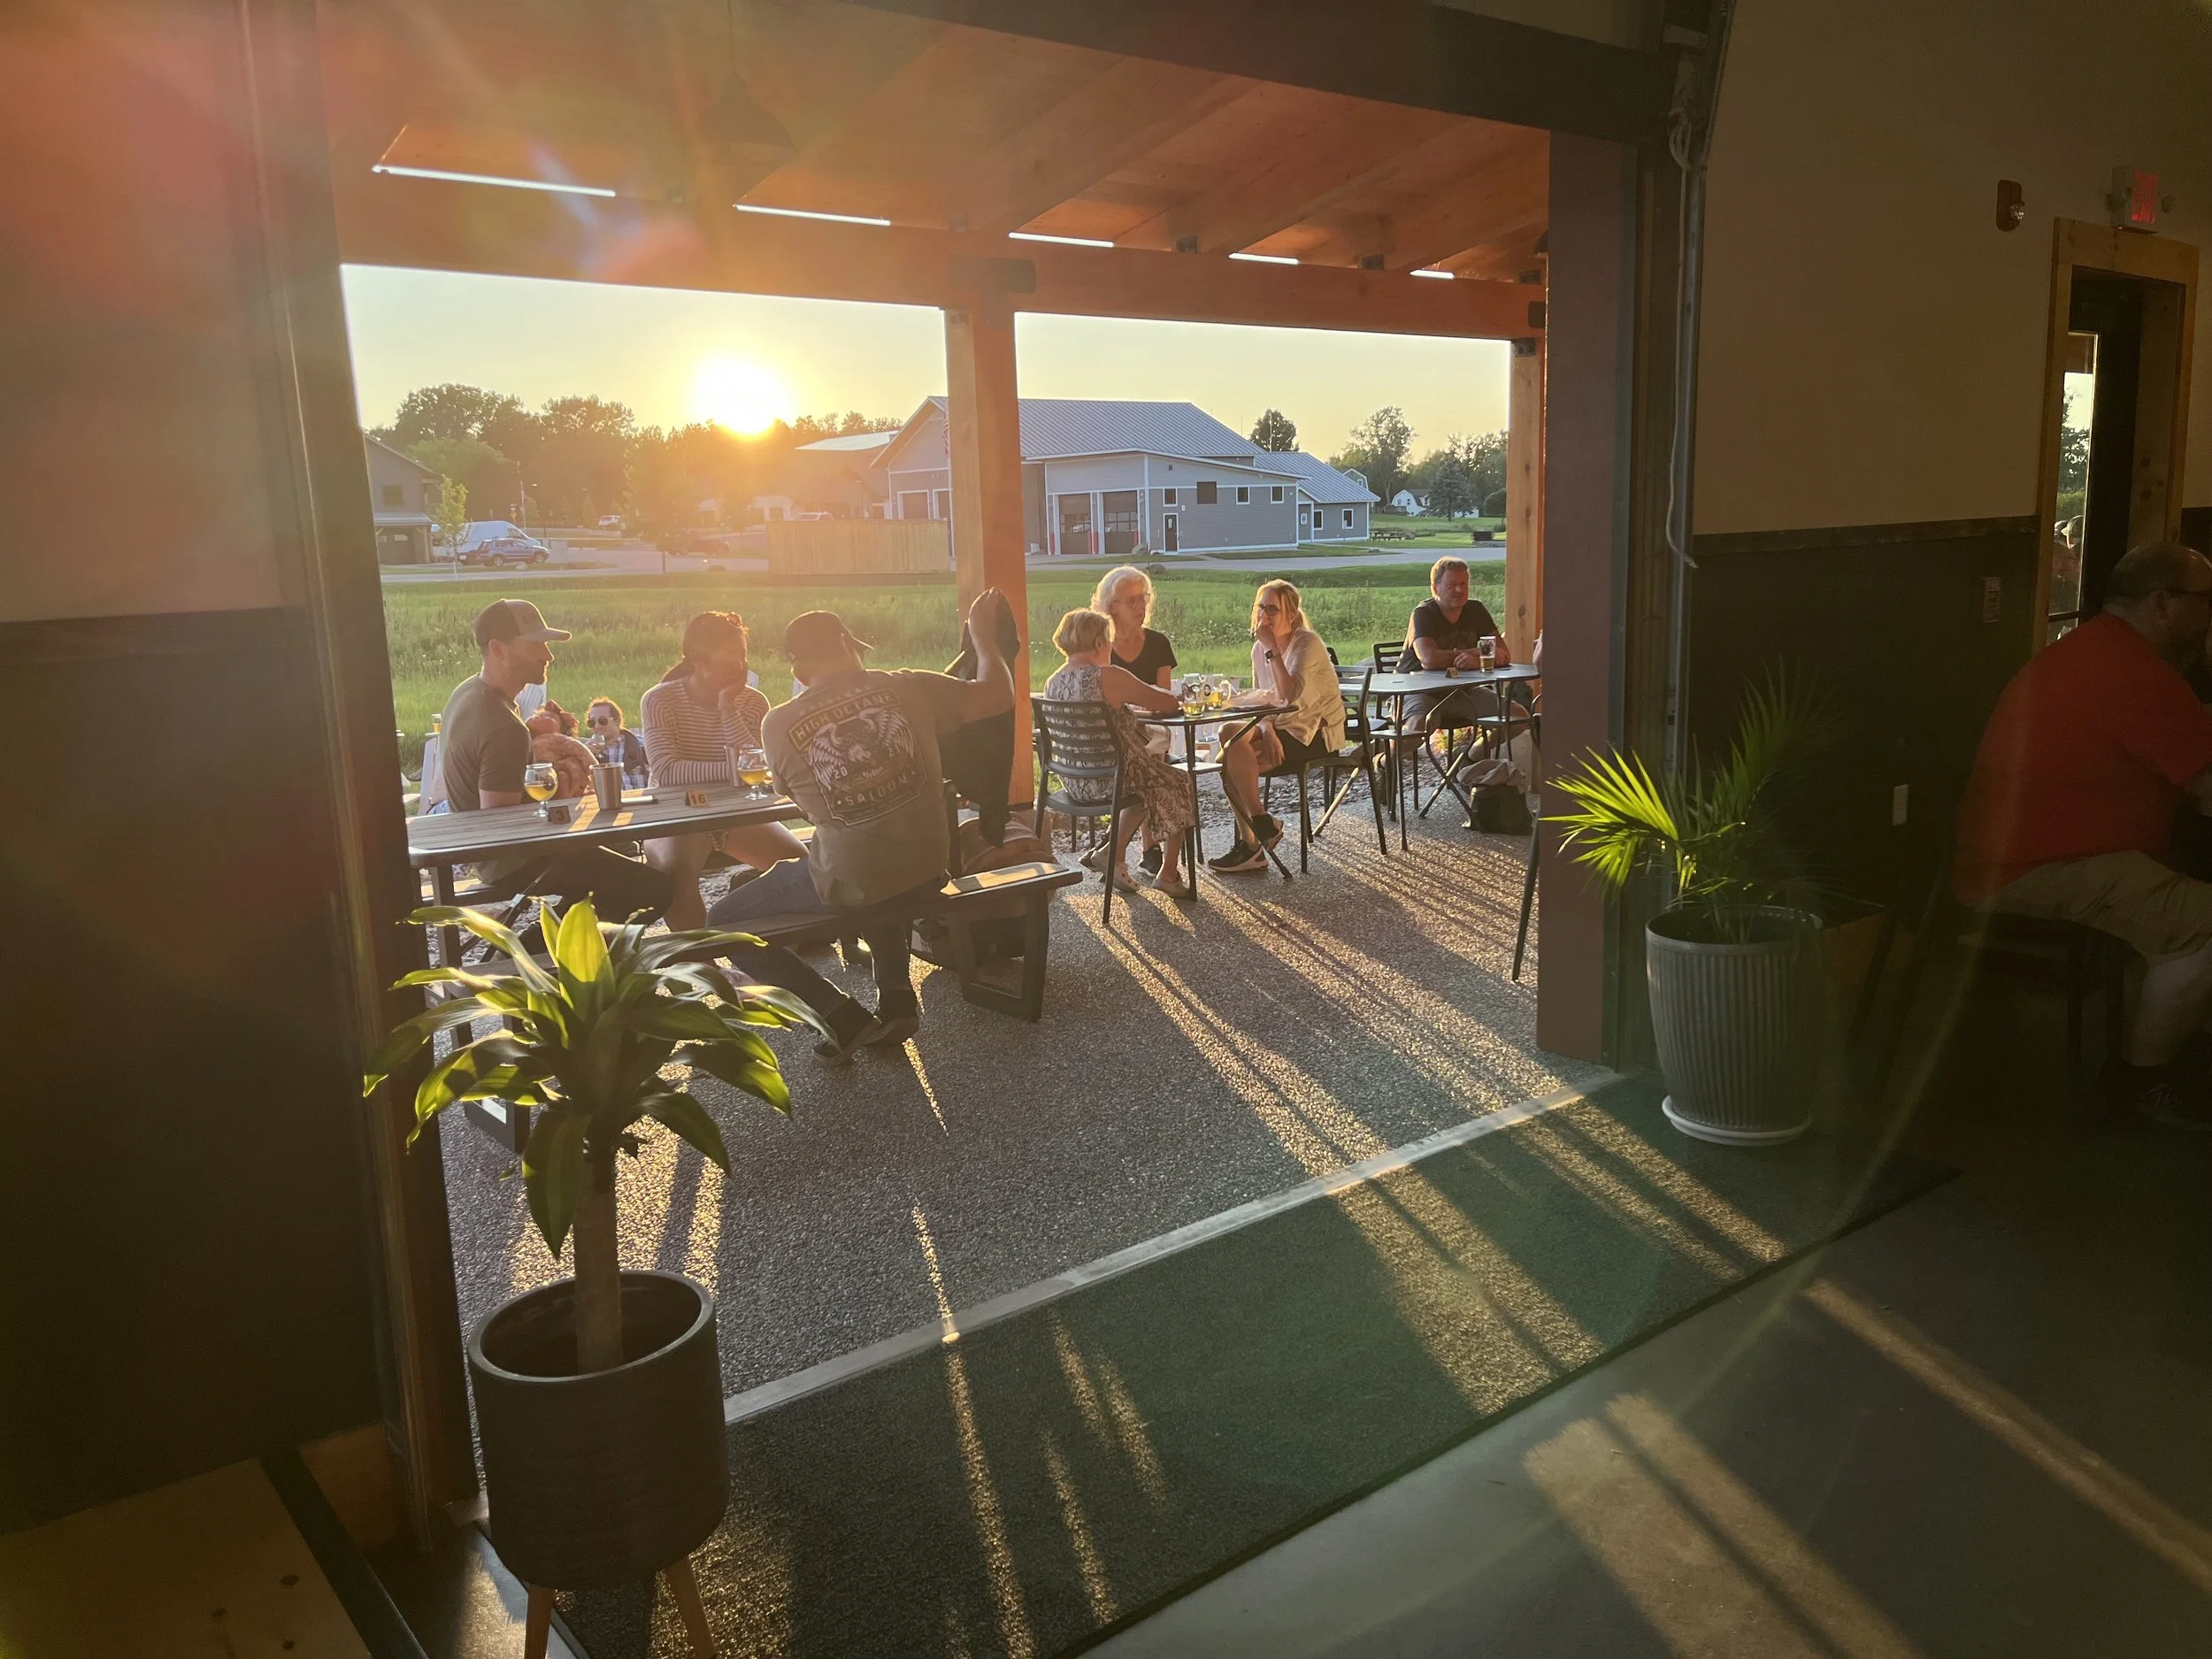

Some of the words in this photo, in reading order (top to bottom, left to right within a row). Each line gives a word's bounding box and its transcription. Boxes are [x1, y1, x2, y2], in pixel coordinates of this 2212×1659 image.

[795, 716, 829, 740] HIGH
[833, 691, 894, 719] OCTANE
[833, 766, 849, 780] 20
[845, 774, 910, 806] SALOON
[690, 793, 706, 804] 16
[556, 810, 565, 821] 3
